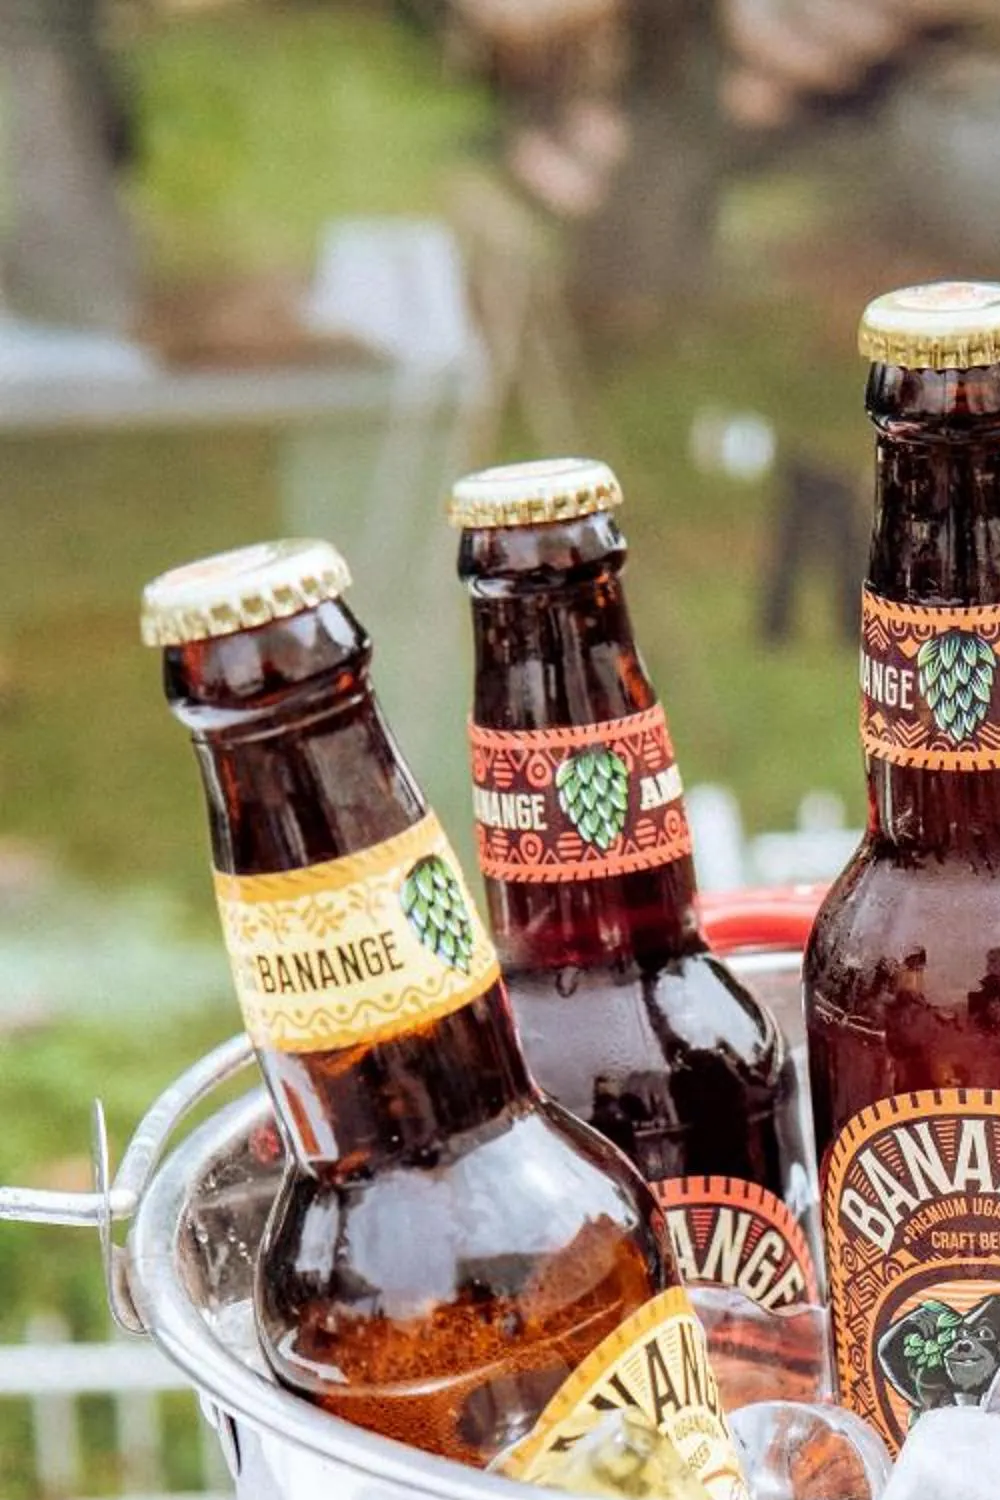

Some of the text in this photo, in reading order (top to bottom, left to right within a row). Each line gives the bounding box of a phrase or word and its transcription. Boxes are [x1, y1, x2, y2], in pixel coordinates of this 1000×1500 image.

[256, 930, 405, 995] BANANGE
[904, 1198, 967, 1241] PREMIUM
[931, 1231, 976, 1250] CRAFT
